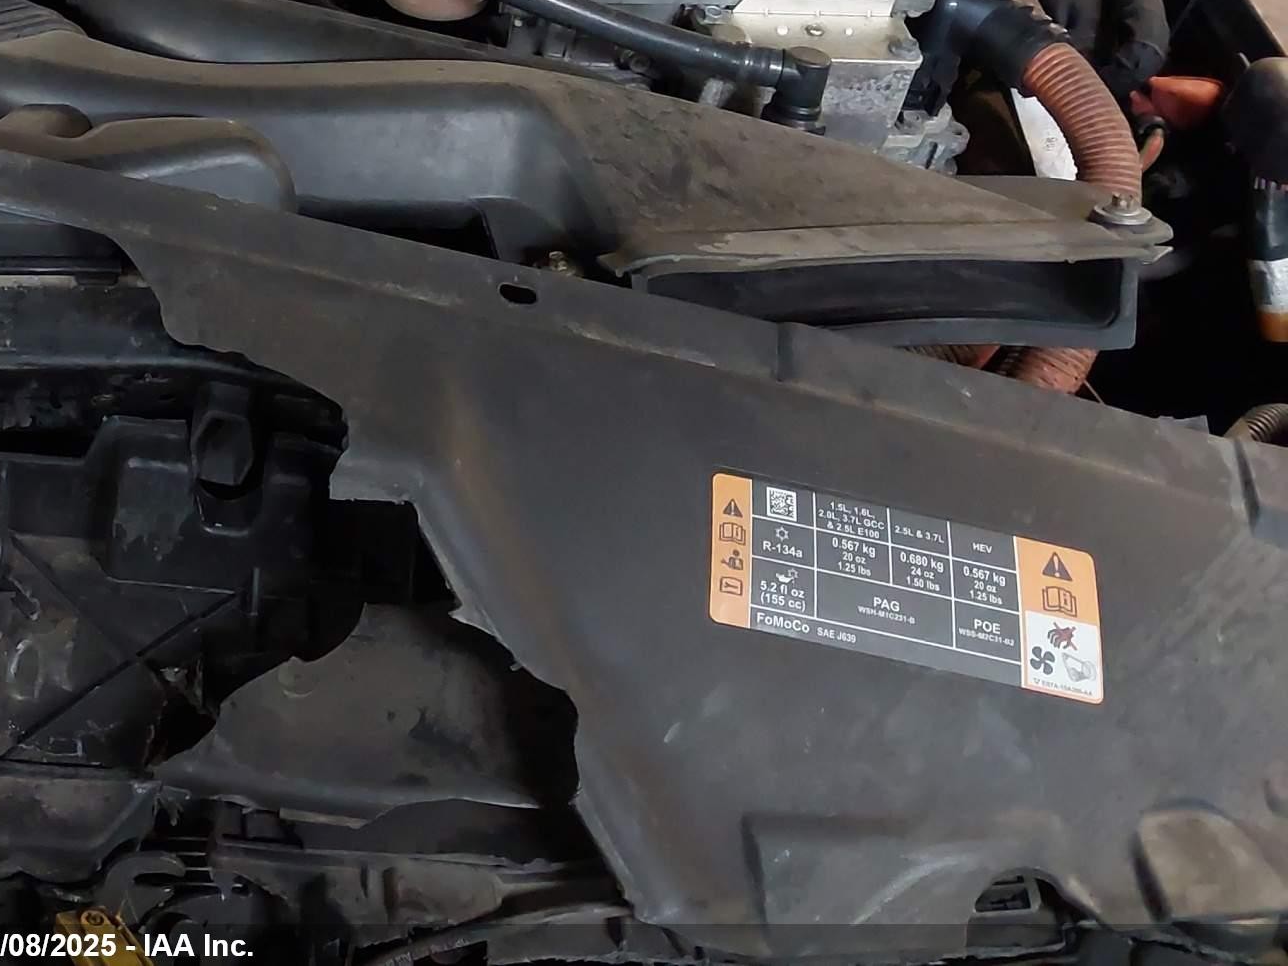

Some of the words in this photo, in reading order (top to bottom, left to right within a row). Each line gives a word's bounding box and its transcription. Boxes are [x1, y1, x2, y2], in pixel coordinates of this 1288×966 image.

[827, 521, 834, 529] &
[836, 523, 855, 534] 2.5L
[857, 527, 880, 539] E100
[843, 514, 861, 525] 3.7L
[864, 519, 885, 530] GCC
[894, 525, 914, 536] 2.5L
[925, 532, 945, 543] 3.7L
[762, 540, 802, 558] R-134a
[832, 537, 860, 552] 0.567
[862, 543, 876, 558] kg
[972, 542, 993, 554] HEV
[842, 552, 853, 562] 20
[855, 555, 866, 565] oz
[900, 552, 928, 567] 0.680
[930, 559, 944, 573] kg
[838, 561, 856, 573] 1.25
[857, 565, 871, 576] lbs
[911, 566, 922, 576] 24
[924, 571, 935, 579] oz
[963, 566, 990, 580] 0.567
[992, 572, 1006, 586] kg
[760, 580, 777, 593] 5.2
[780, 585, 788, 595] fl
[791, 589, 805, 599] oz
[906, 576, 924, 588] 1.50
[926, 580, 940, 591] lbs
[974, 581, 984, 590] 20
[986, 585, 997, 593] oz
[760, 593, 785, 606] (155
[788, 599, 806, 613] cc)
[873, 596, 900, 612] PAG
[970, 590, 987, 602] 1.25
[989, 593, 1003, 605] lbs
[756, 612, 810, 634] FoMoCo
[817, 627, 835, 639] SAE
[837, 630, 857, 643] J639
[974, 618, 1001, 635] POE
